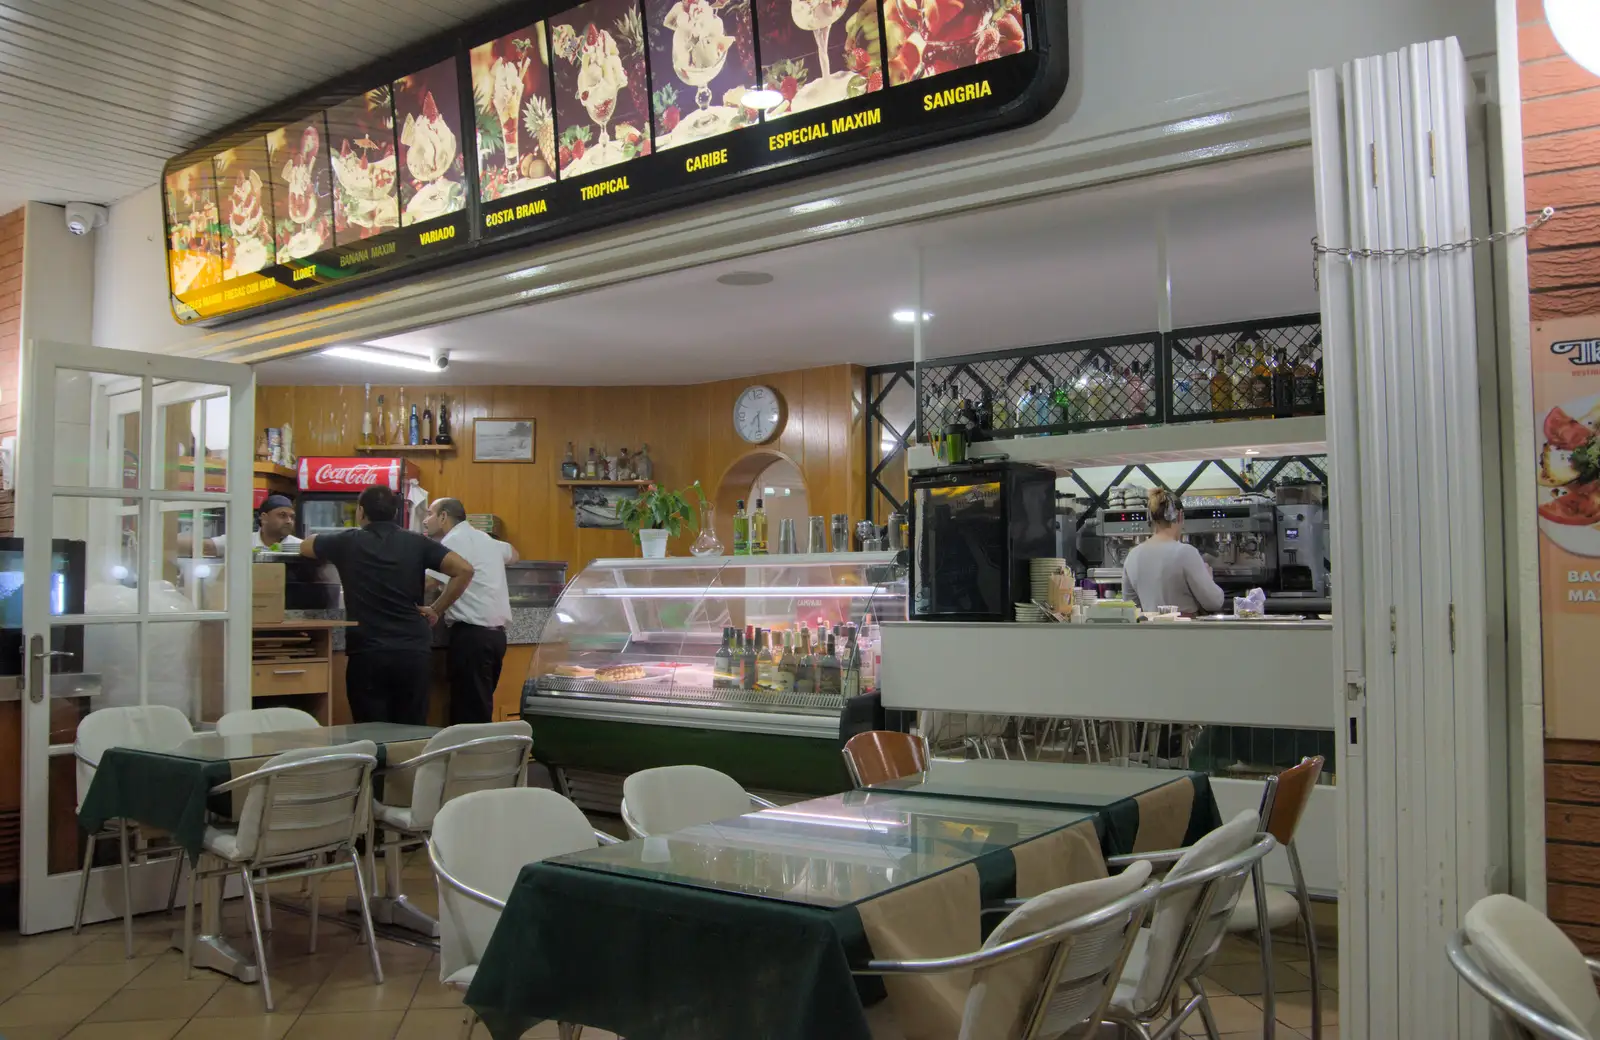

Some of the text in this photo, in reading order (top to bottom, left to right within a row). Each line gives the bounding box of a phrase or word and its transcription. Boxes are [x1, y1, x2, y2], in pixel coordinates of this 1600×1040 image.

[923, 80, 992, 111] SANGRIA
[768, 108, 881, 151] ESPECIAL MAXIM
[685, 149, 728, 172] CARIBE
[580, 176, 630, 201] TROPICAL
[485, 199, 547, 227] COSTA BRAVA
[419, 225, 456, 246] VARIADO
[340, 241, 396, 267] BANANA MAXIM
[1568, 589, 1600, 602] MA
